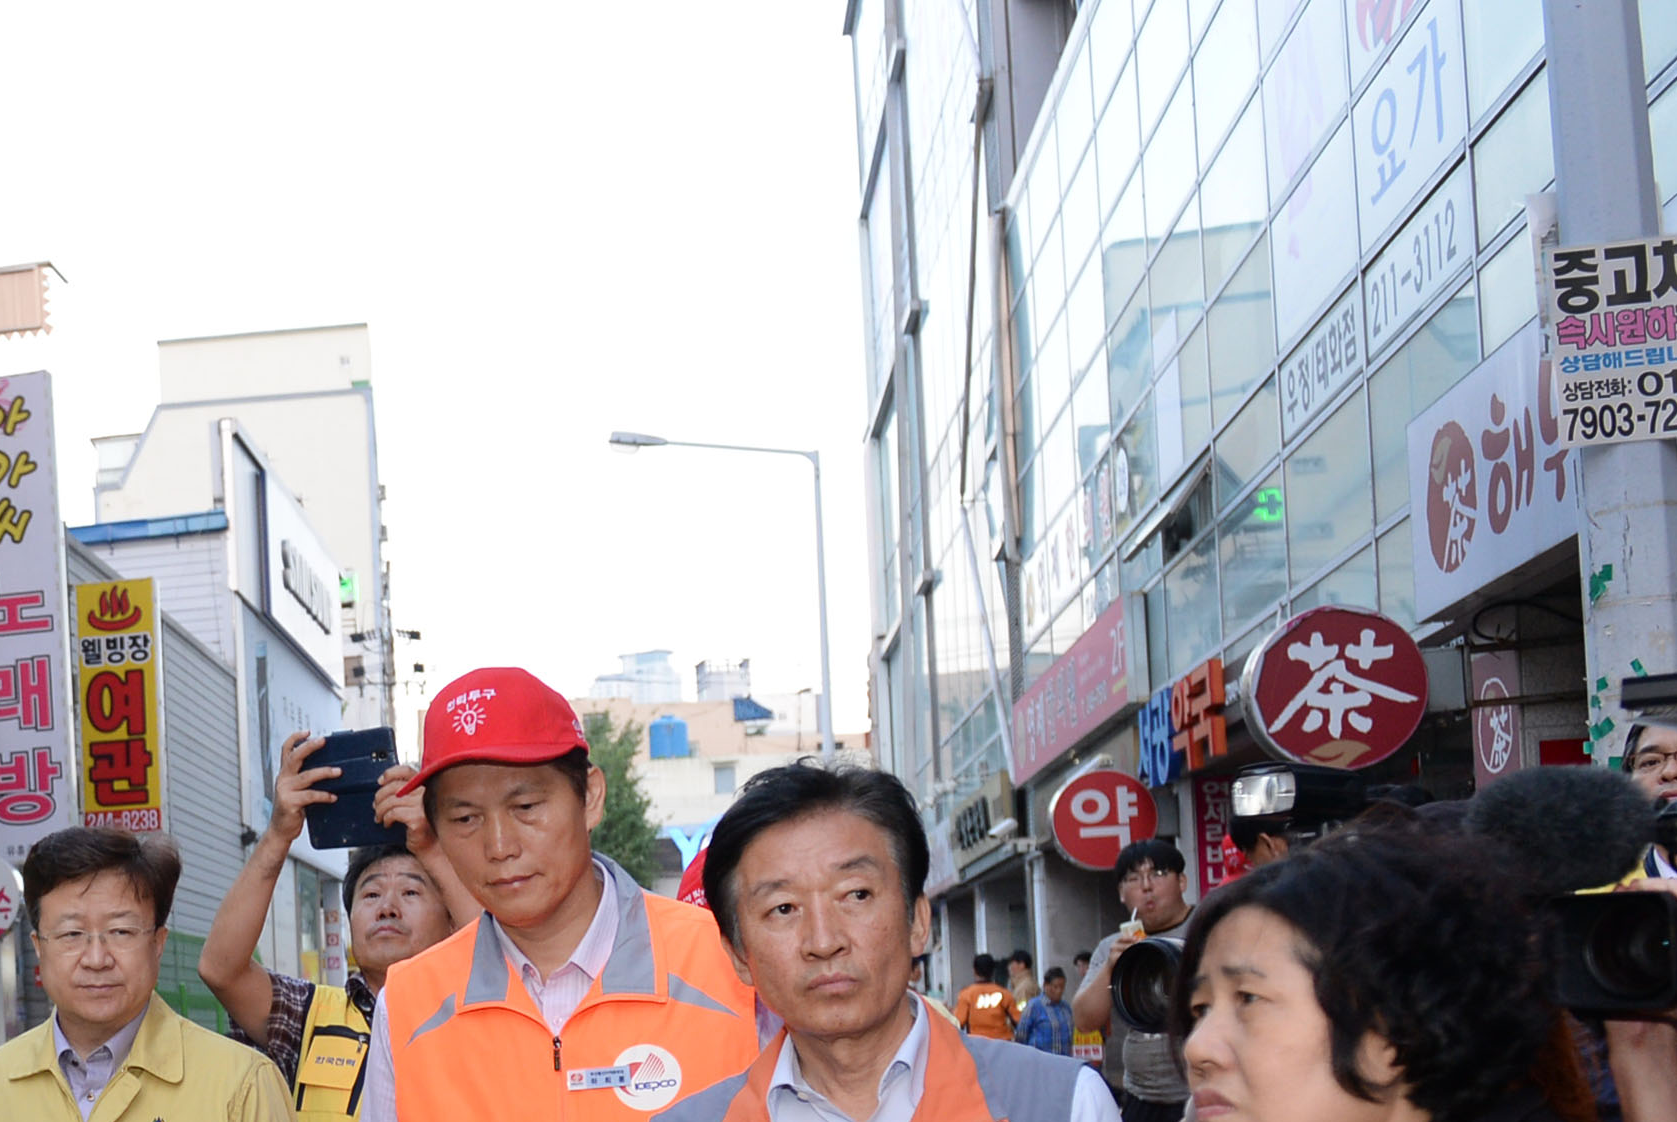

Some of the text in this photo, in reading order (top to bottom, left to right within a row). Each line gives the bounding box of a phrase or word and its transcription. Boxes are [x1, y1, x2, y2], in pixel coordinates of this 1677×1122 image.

[1370, 16, 1447, 207] 요가
[1369, 198, 1458, 338] 211-3112
[1562, 378, 1633, 401] 상담전화:
[80, 634, 151, 666] 웰빙장
[1268, 628, 1419, 740] 茶
[85, 668, 153, 807] 여관
[87, 811, 159, 836] 244-8238
[1070, 784, 1139, 849] 약
